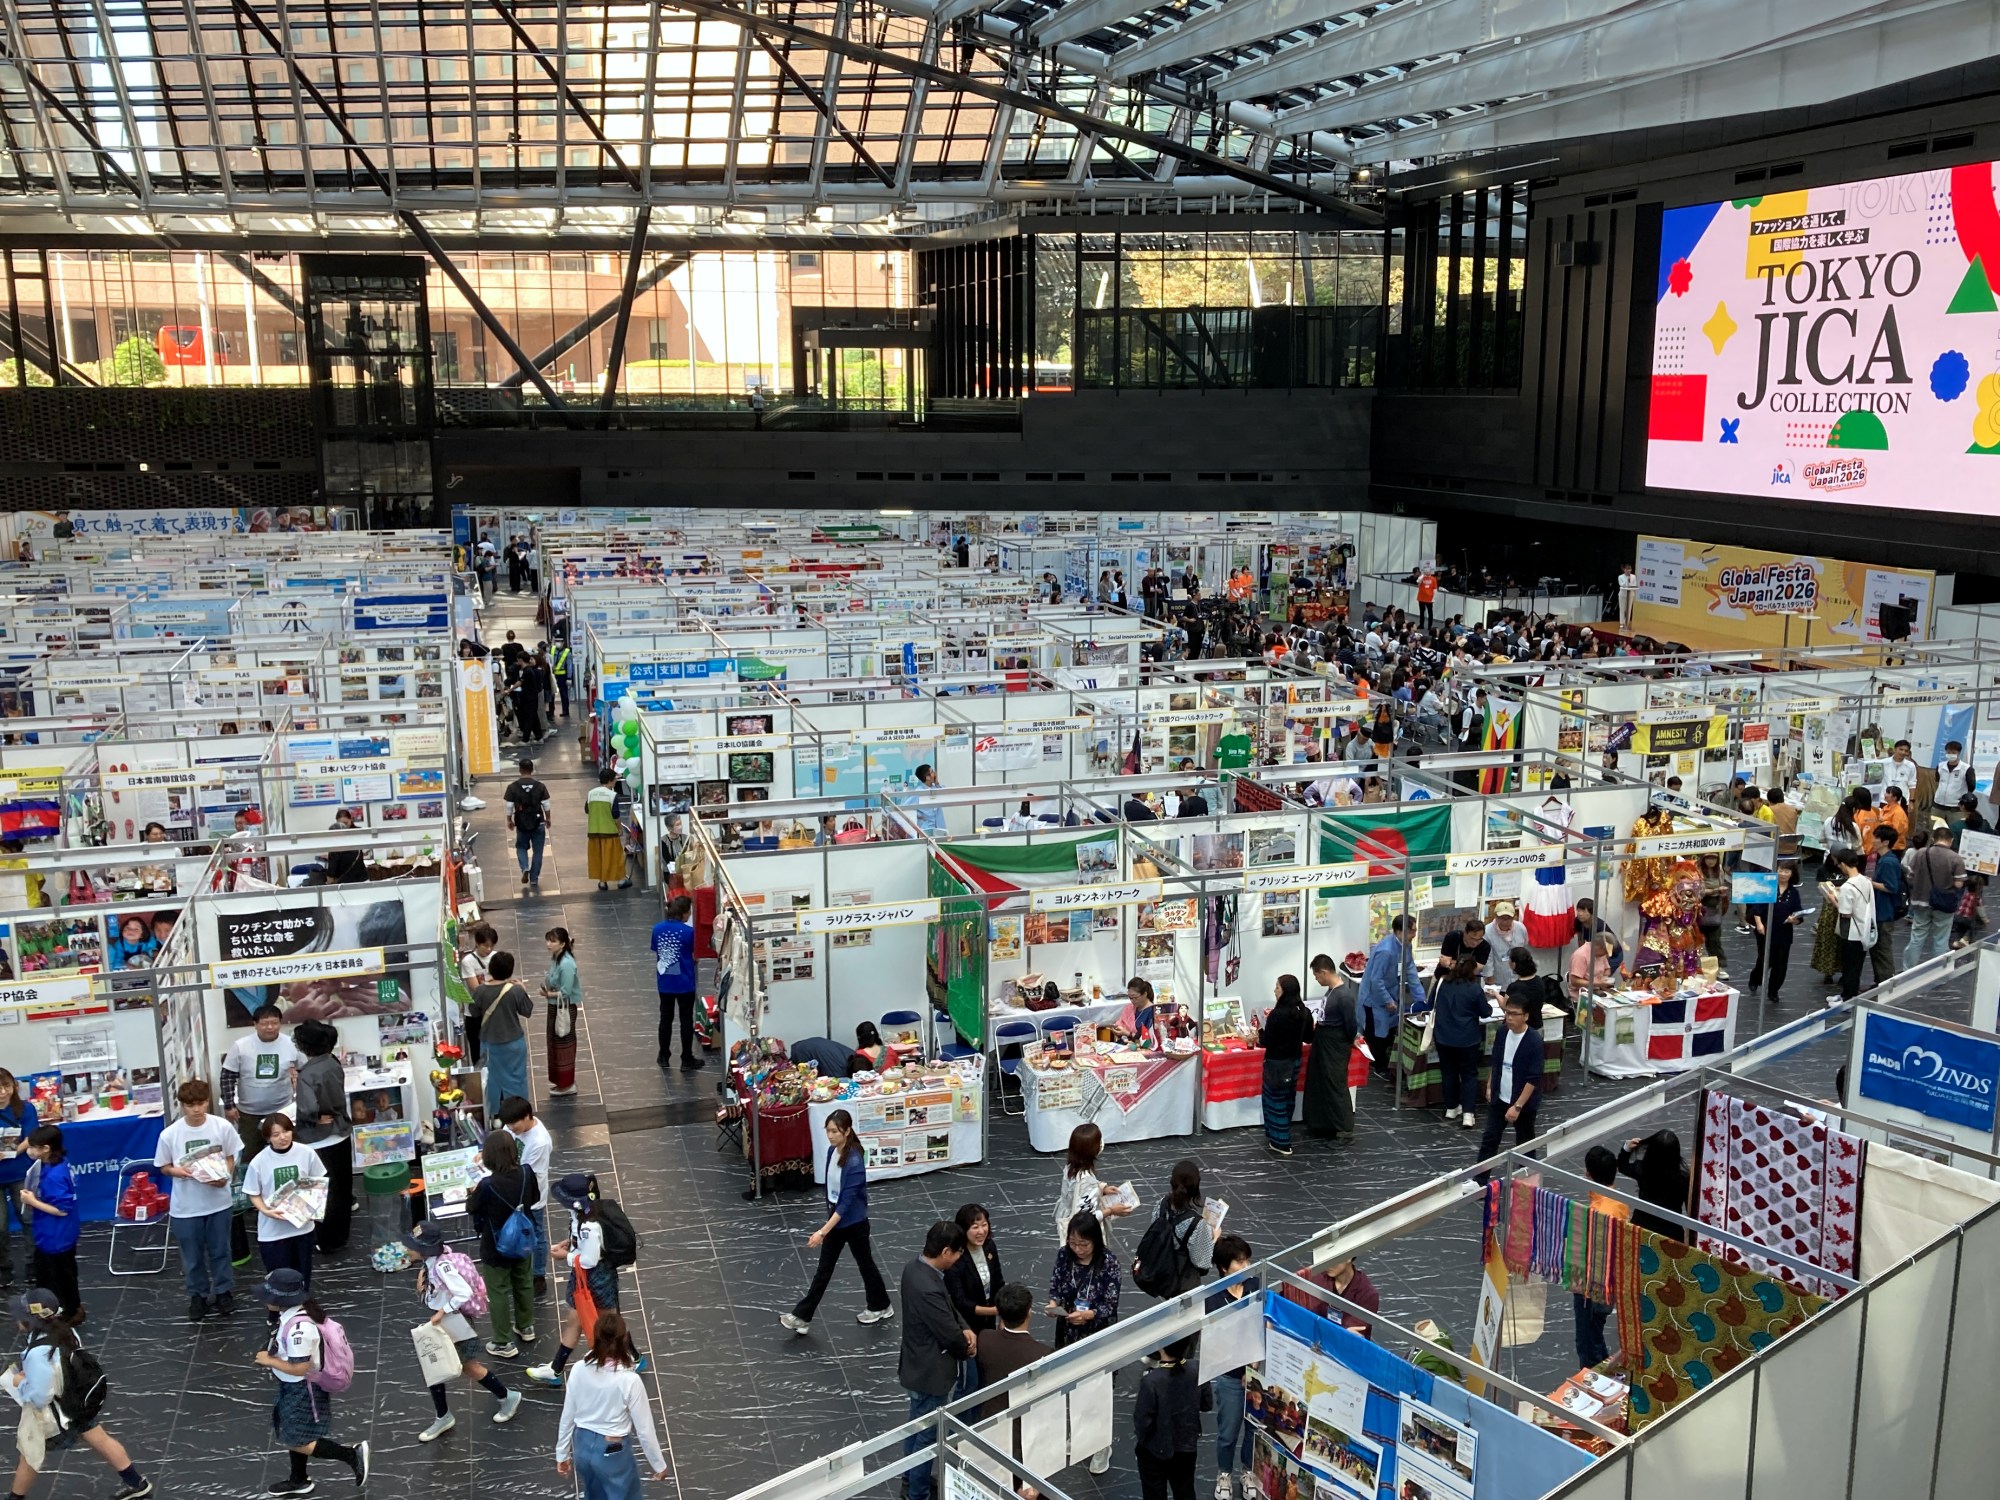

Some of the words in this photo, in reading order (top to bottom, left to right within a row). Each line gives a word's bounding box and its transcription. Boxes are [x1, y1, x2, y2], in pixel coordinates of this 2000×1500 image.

[1755, 213, 1841, 235] ファッションを通して、
[1773, 229, 1865, 252] 国際協力を楽しく学ぶ
[1758, 250, 1921, 306] TOKYO
[1737, 304, 1913, 411] JICA
[1770, 391, 1912, 416] COLLECTION
[1804, 464, 1834, 478] Global
[1835, 460, 1863, 475] Festa
[1810, 475, 1839, 487] Japan
[1840, 469, 1865, 483] 2026
[1721, 567, 1766, 587] Global
[1767, 566, 1811, 587] Festa
[1730, 587, 1773, 604] Japan
[1774, 582, 1815, 600] 2026
[379, 664, 414, 672] International
[632, 665, 653, 676] 公式
[659, 664, 680, 675] 支援
[686, 664, 707, 674] 窓口
[1306, 705, 1351, 715] 協力隊ネパール会
[1656, 728, 1688, 739] AMNESTY
[717, 739, 763, 749] 日本ILO協議会
[320, 762, 386, 774] 日本ハビタット協会
[1658, 837, 1726, 851] ドミニカ共和国OV会
[1465, 852, 1546, 868] バングラデシュOVの会
[1259, 876, 1289, 886] ブリッジ
[1292, 872, 1323, 883] エーシア
[1325, 869, 1356, 881] ジャパン
[1055, 888, 1140, 905] ヨルダンネットワーク
[826, 909, 914, 925] ラリグラス・ジャパン
[1164, 909, 1187, 918] ヨルダン
[229, 916, 315, 934] ワクチンで助かる
[230, 932, 295, 945] ちいさな命を
[231, 945, 275, 959] 救いたい
[232, 961, 322, 980] 世界の子どもにワクチンを
[325, 957, 364, 971] 日本委員会
